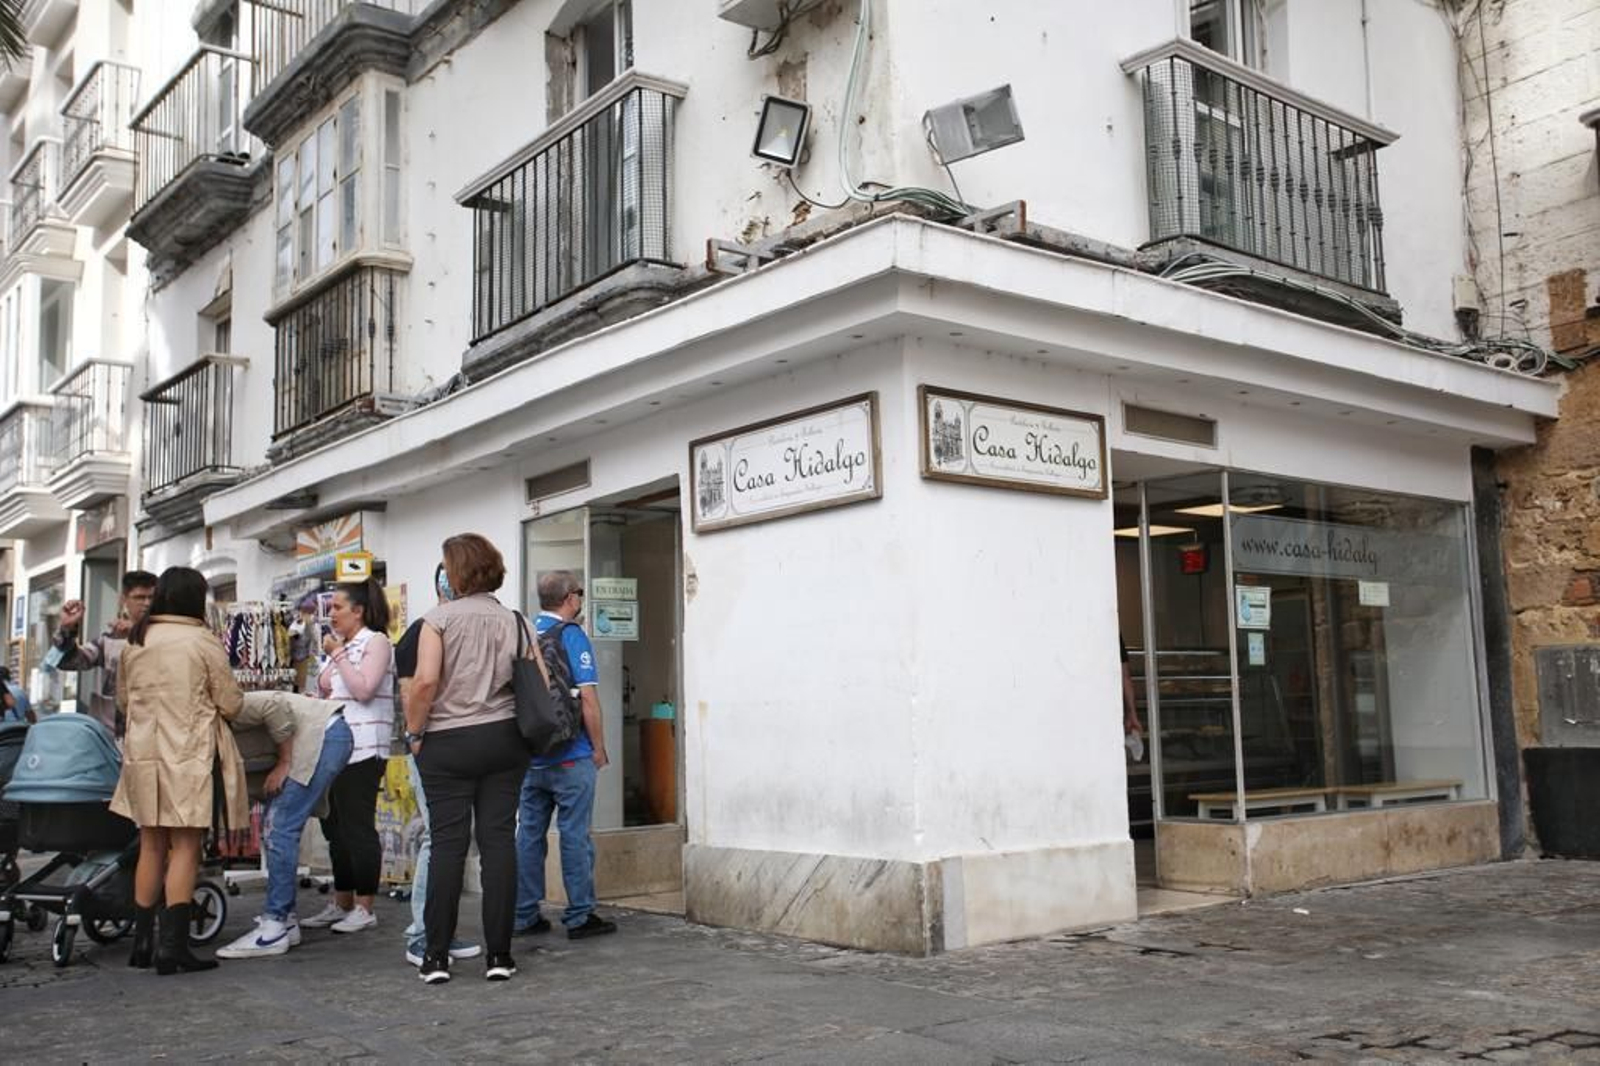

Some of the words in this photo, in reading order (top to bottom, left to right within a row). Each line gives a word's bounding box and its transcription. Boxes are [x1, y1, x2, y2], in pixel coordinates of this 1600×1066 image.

[733, 458, 776, 493] Casa
[784, 438, 866, 485] Hidalgo
[972, 425, 1017, 460] Casa
[1025, 432, 1097, 480] Hidalgo
[595, 586, 634, 596] ENTRADA
